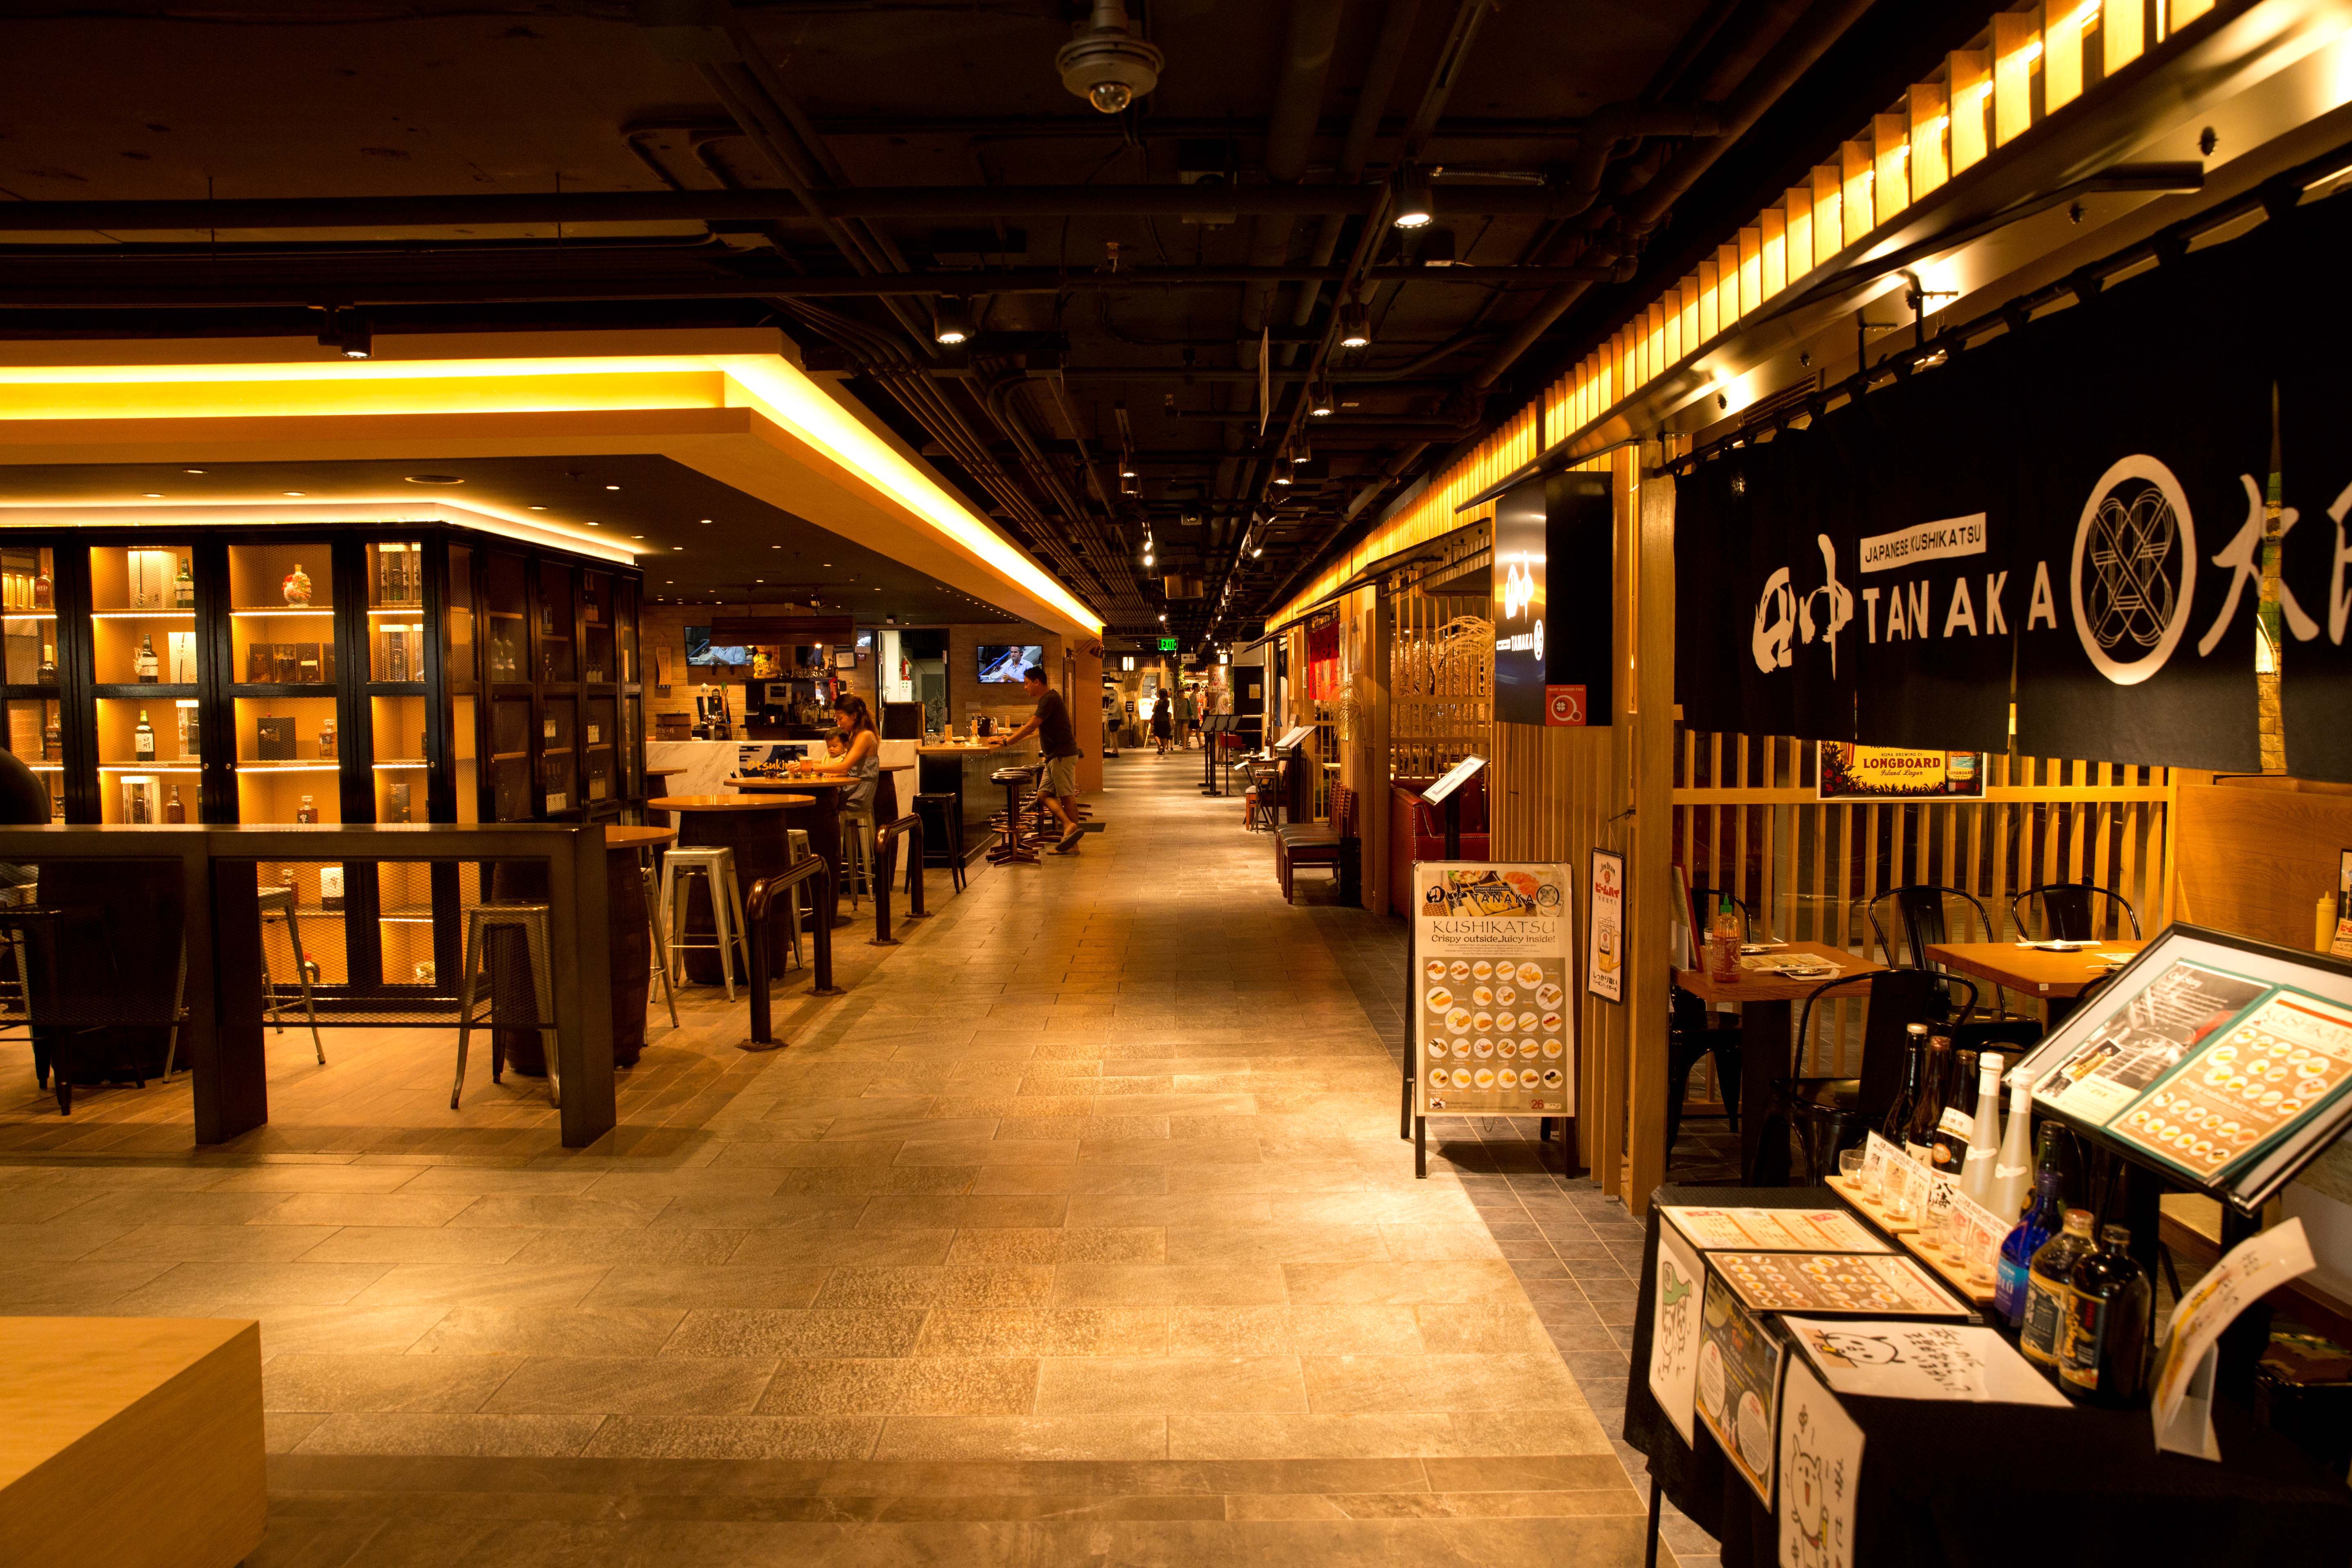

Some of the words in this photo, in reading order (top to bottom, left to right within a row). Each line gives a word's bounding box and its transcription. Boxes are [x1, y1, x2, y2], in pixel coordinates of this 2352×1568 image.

[1865, 538, 1909, 563] JAPANESE
[1910, 524, 1981, 553] KUSHIKATSU
[1863, 561, 2057, 644] TANAKA
[1161, 639, 1175, 649] EXIT
[1511, 633, 1533, 651] TANAKA
[1863, 757, 1941, 768] LONGBOARD
[1904, 769, 1923, 778] Lager
[1473, 893, 1534, 904] TANAKA
[1433, 920, 1555, 933] KUSHIKATSU
[1432, 934, 1461, 943] Crispy
[1531, 1099, 1544, 1109] 26
